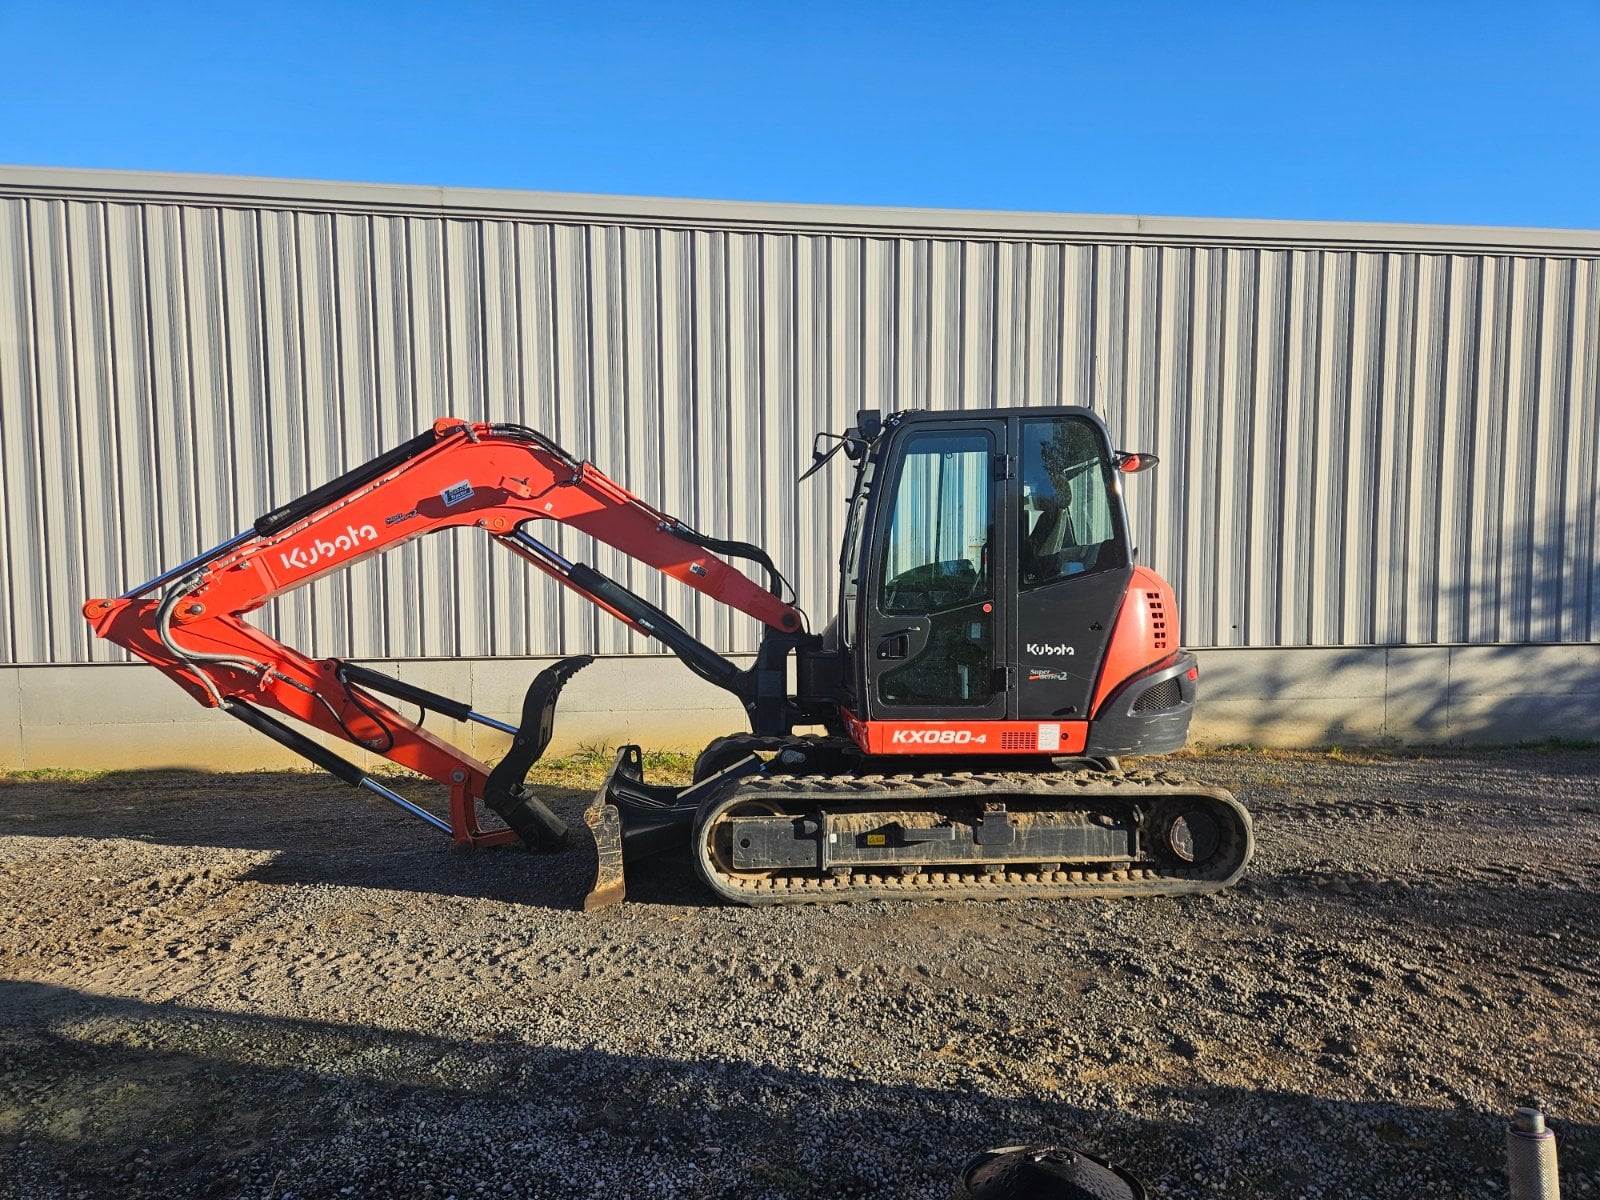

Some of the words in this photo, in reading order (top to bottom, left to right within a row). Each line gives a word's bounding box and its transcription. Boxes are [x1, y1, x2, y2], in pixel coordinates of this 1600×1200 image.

[280, 525, 378, 569] Kubota
[1026, 643, 1075, 655] Kubota
[892, 730, 987, 744] KX080-4
